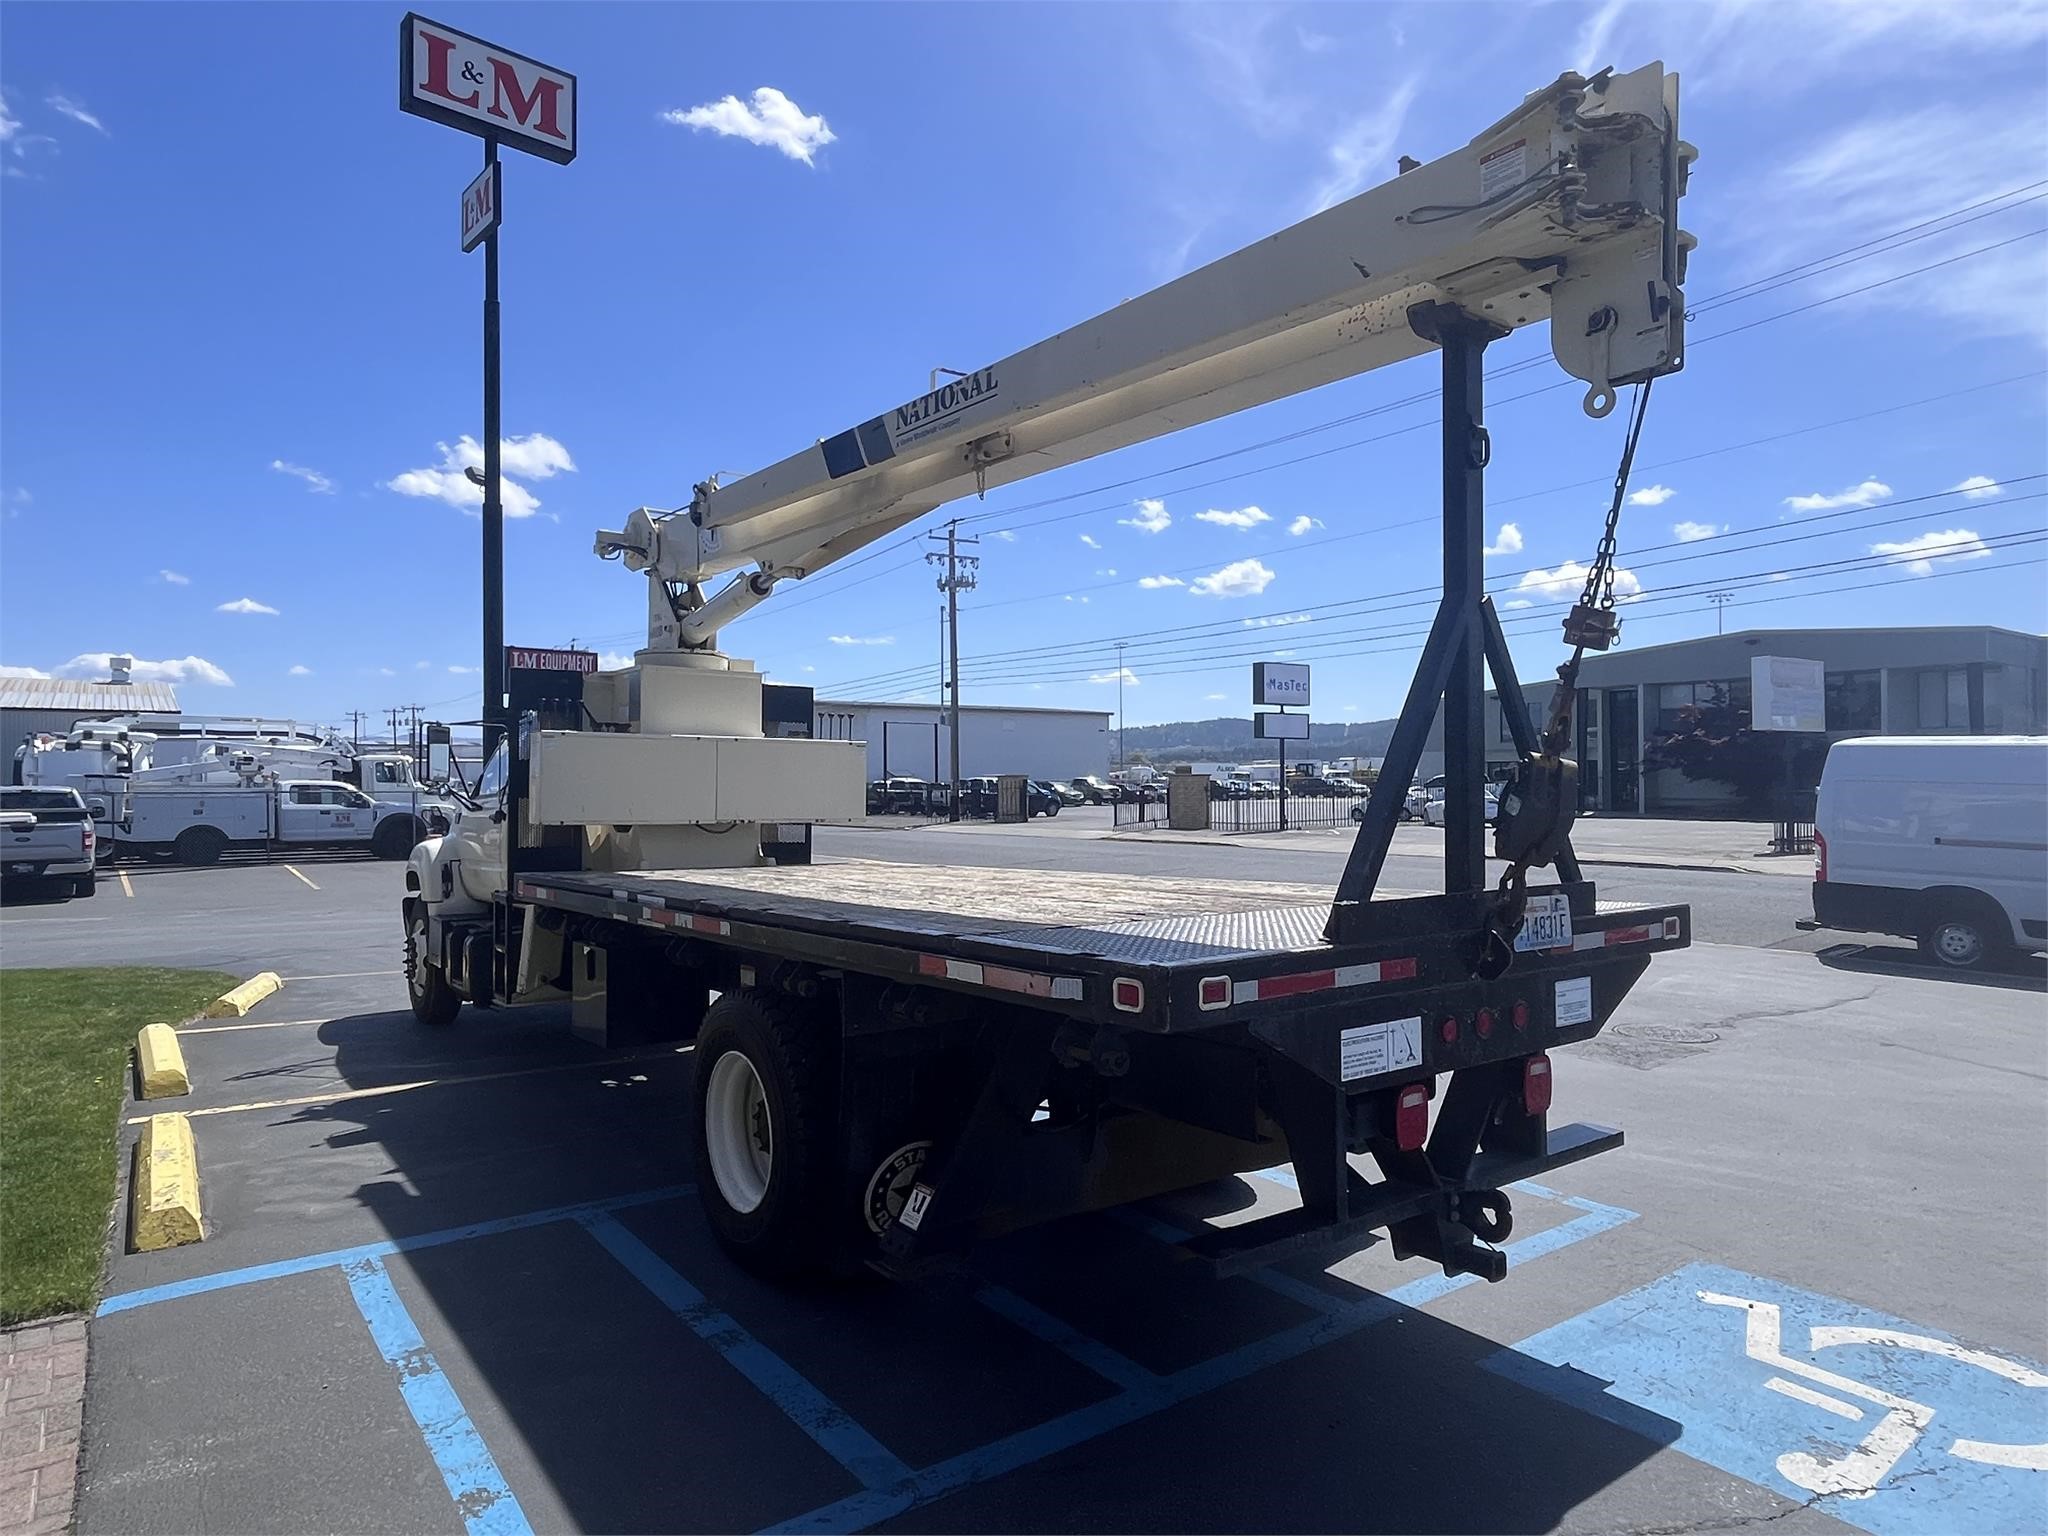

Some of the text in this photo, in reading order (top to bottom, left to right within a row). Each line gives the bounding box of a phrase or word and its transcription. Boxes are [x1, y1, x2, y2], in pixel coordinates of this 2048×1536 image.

[419, 30, 567, 140] L&M
[463, 176, 492, 235] L&M
[896, 365, 999, 430] NATIONAL
[540, 653, 594, 672] EQUIPMENT
[1269, 678, 1307, 691] MasTec
[1520, 913, 1566, 941] 14831F
